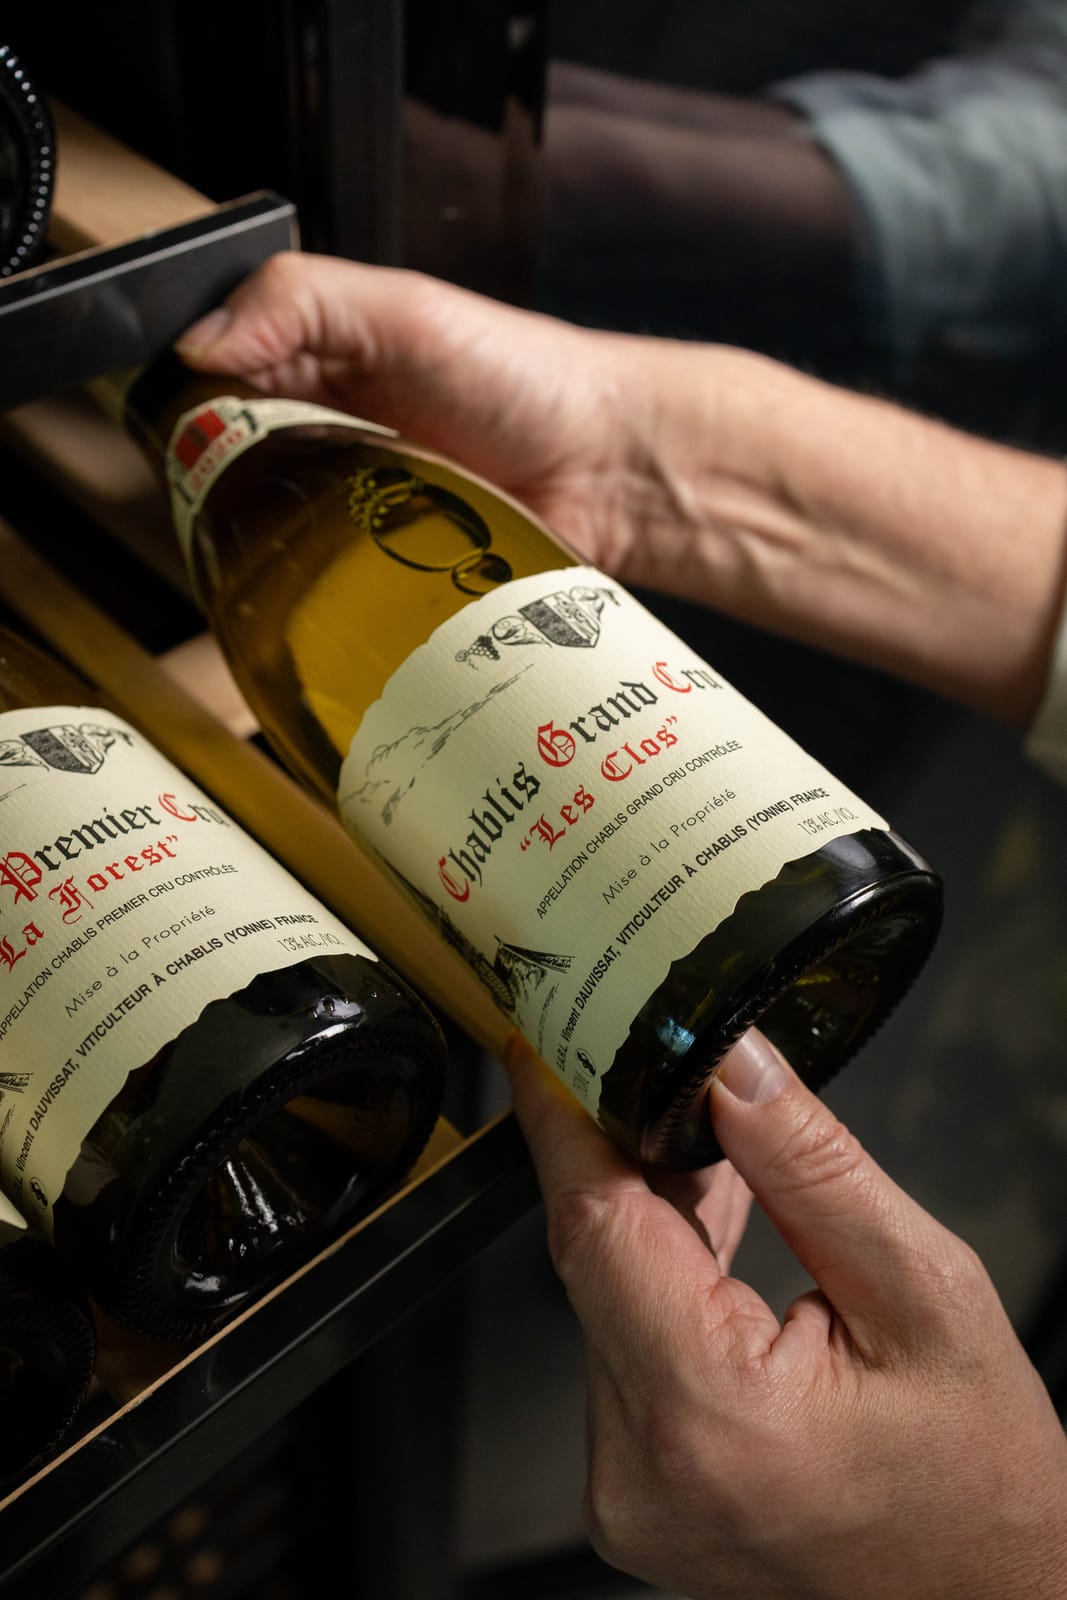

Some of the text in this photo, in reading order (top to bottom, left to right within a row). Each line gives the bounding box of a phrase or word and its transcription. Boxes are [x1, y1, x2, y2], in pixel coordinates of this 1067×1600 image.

[0, 792, 231, 905] Premier Cru
[438, 661, 724, 903] Chablis Grand Cru
[519, 784, 596, 852] “Les
[535, 740, 743, 919] APPELLATION CHABLIS GRAND CRU CONTRÔLÉE
[602, 788, 737, 905] Mise à la Propriété
[0, 864, 239, 1040] APPELLATION CHABLIS PREMIER CRU CONTRÔLÉE
[64, 904, 216, 1019] Mise à la Propriété
[560, 1007, 581, 1043] Vincent
[574, 945, 622, 1010] DAUVISSAT,
[616, 874, 686, 947] VITICULTEUR
[681, 863, 698, 878] À
[695, 825, 748, 867] CHABLIS
[745, 800, 794, 831] (YONNE)
[789, 787, 830, 807] FRANCE
[15, 1130, 35, 1172] Vincent
[29, 1058, 81, 1131] DAUVISSAT,
[75, 983, 153, 1057] VITICULTEUR
[152, 972, 167, 987] À
[166, 937, 224, 976] CHABLIS
[223, 919, 277, 944] (YONNE)
[276, 914, 319, 927] FRANCE
